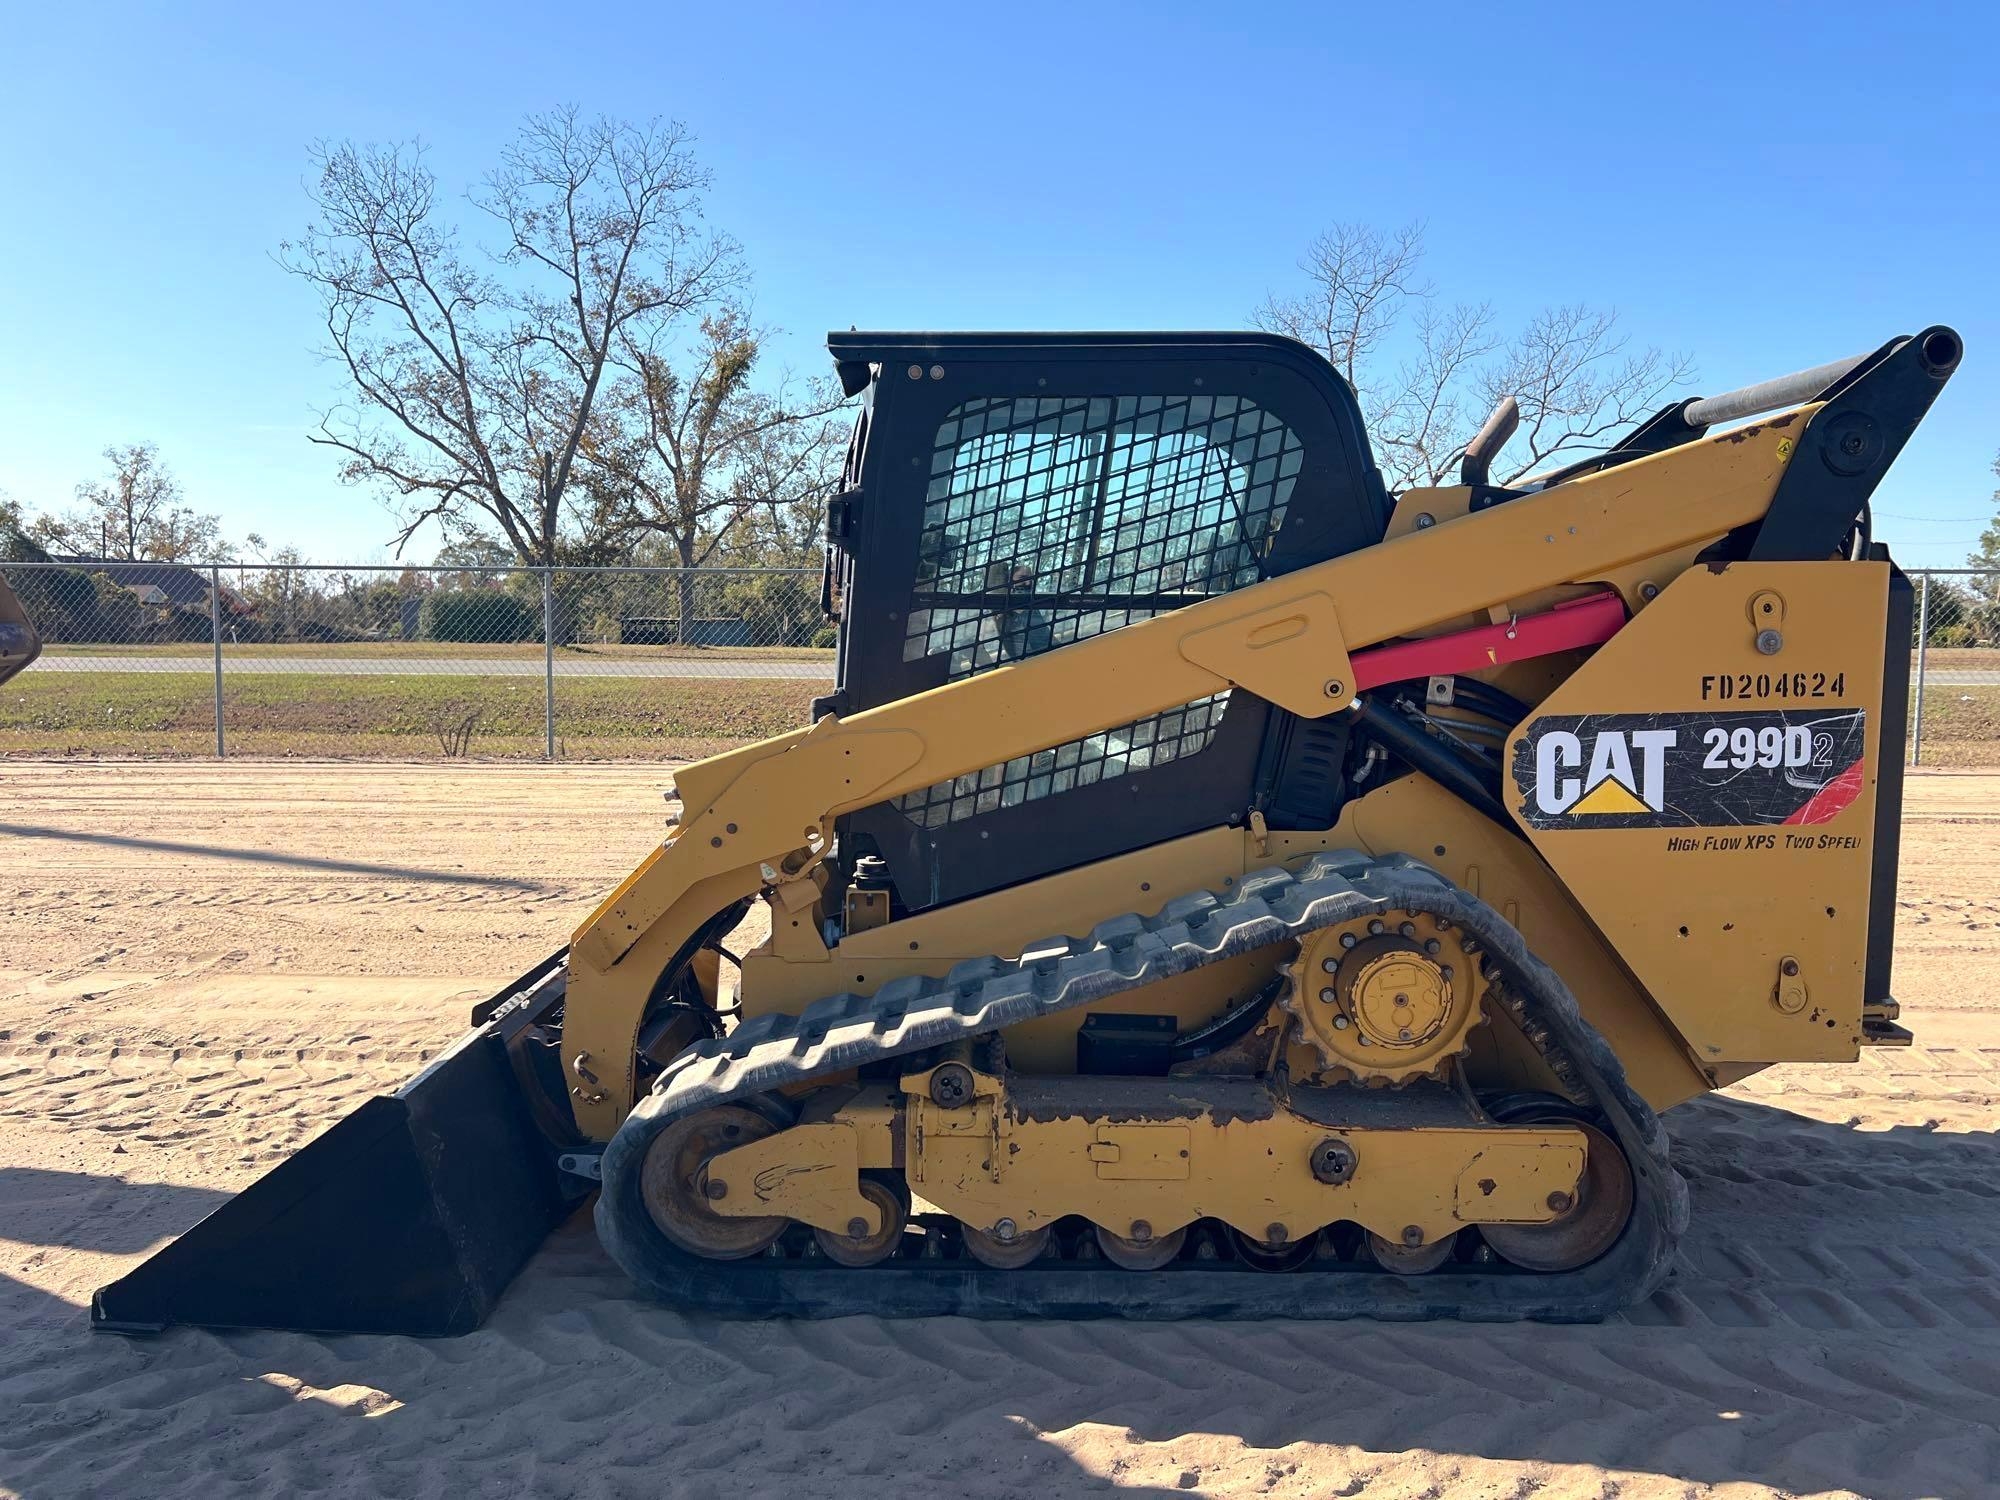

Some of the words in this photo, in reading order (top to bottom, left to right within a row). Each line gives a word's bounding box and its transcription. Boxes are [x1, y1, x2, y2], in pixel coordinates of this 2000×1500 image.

[1702, 673, 1844, 700] FD204624
[1702, 725, 1834, 769] 299D2
[1536, 730, 1677, 815] CAT
[1667, 837, 1699, 851] HIGH
[1704, 836, 1741, 850] FLOW
[1744, 835, 1776, 849] XPS
[1785, 834, 1814, 849] TWO
